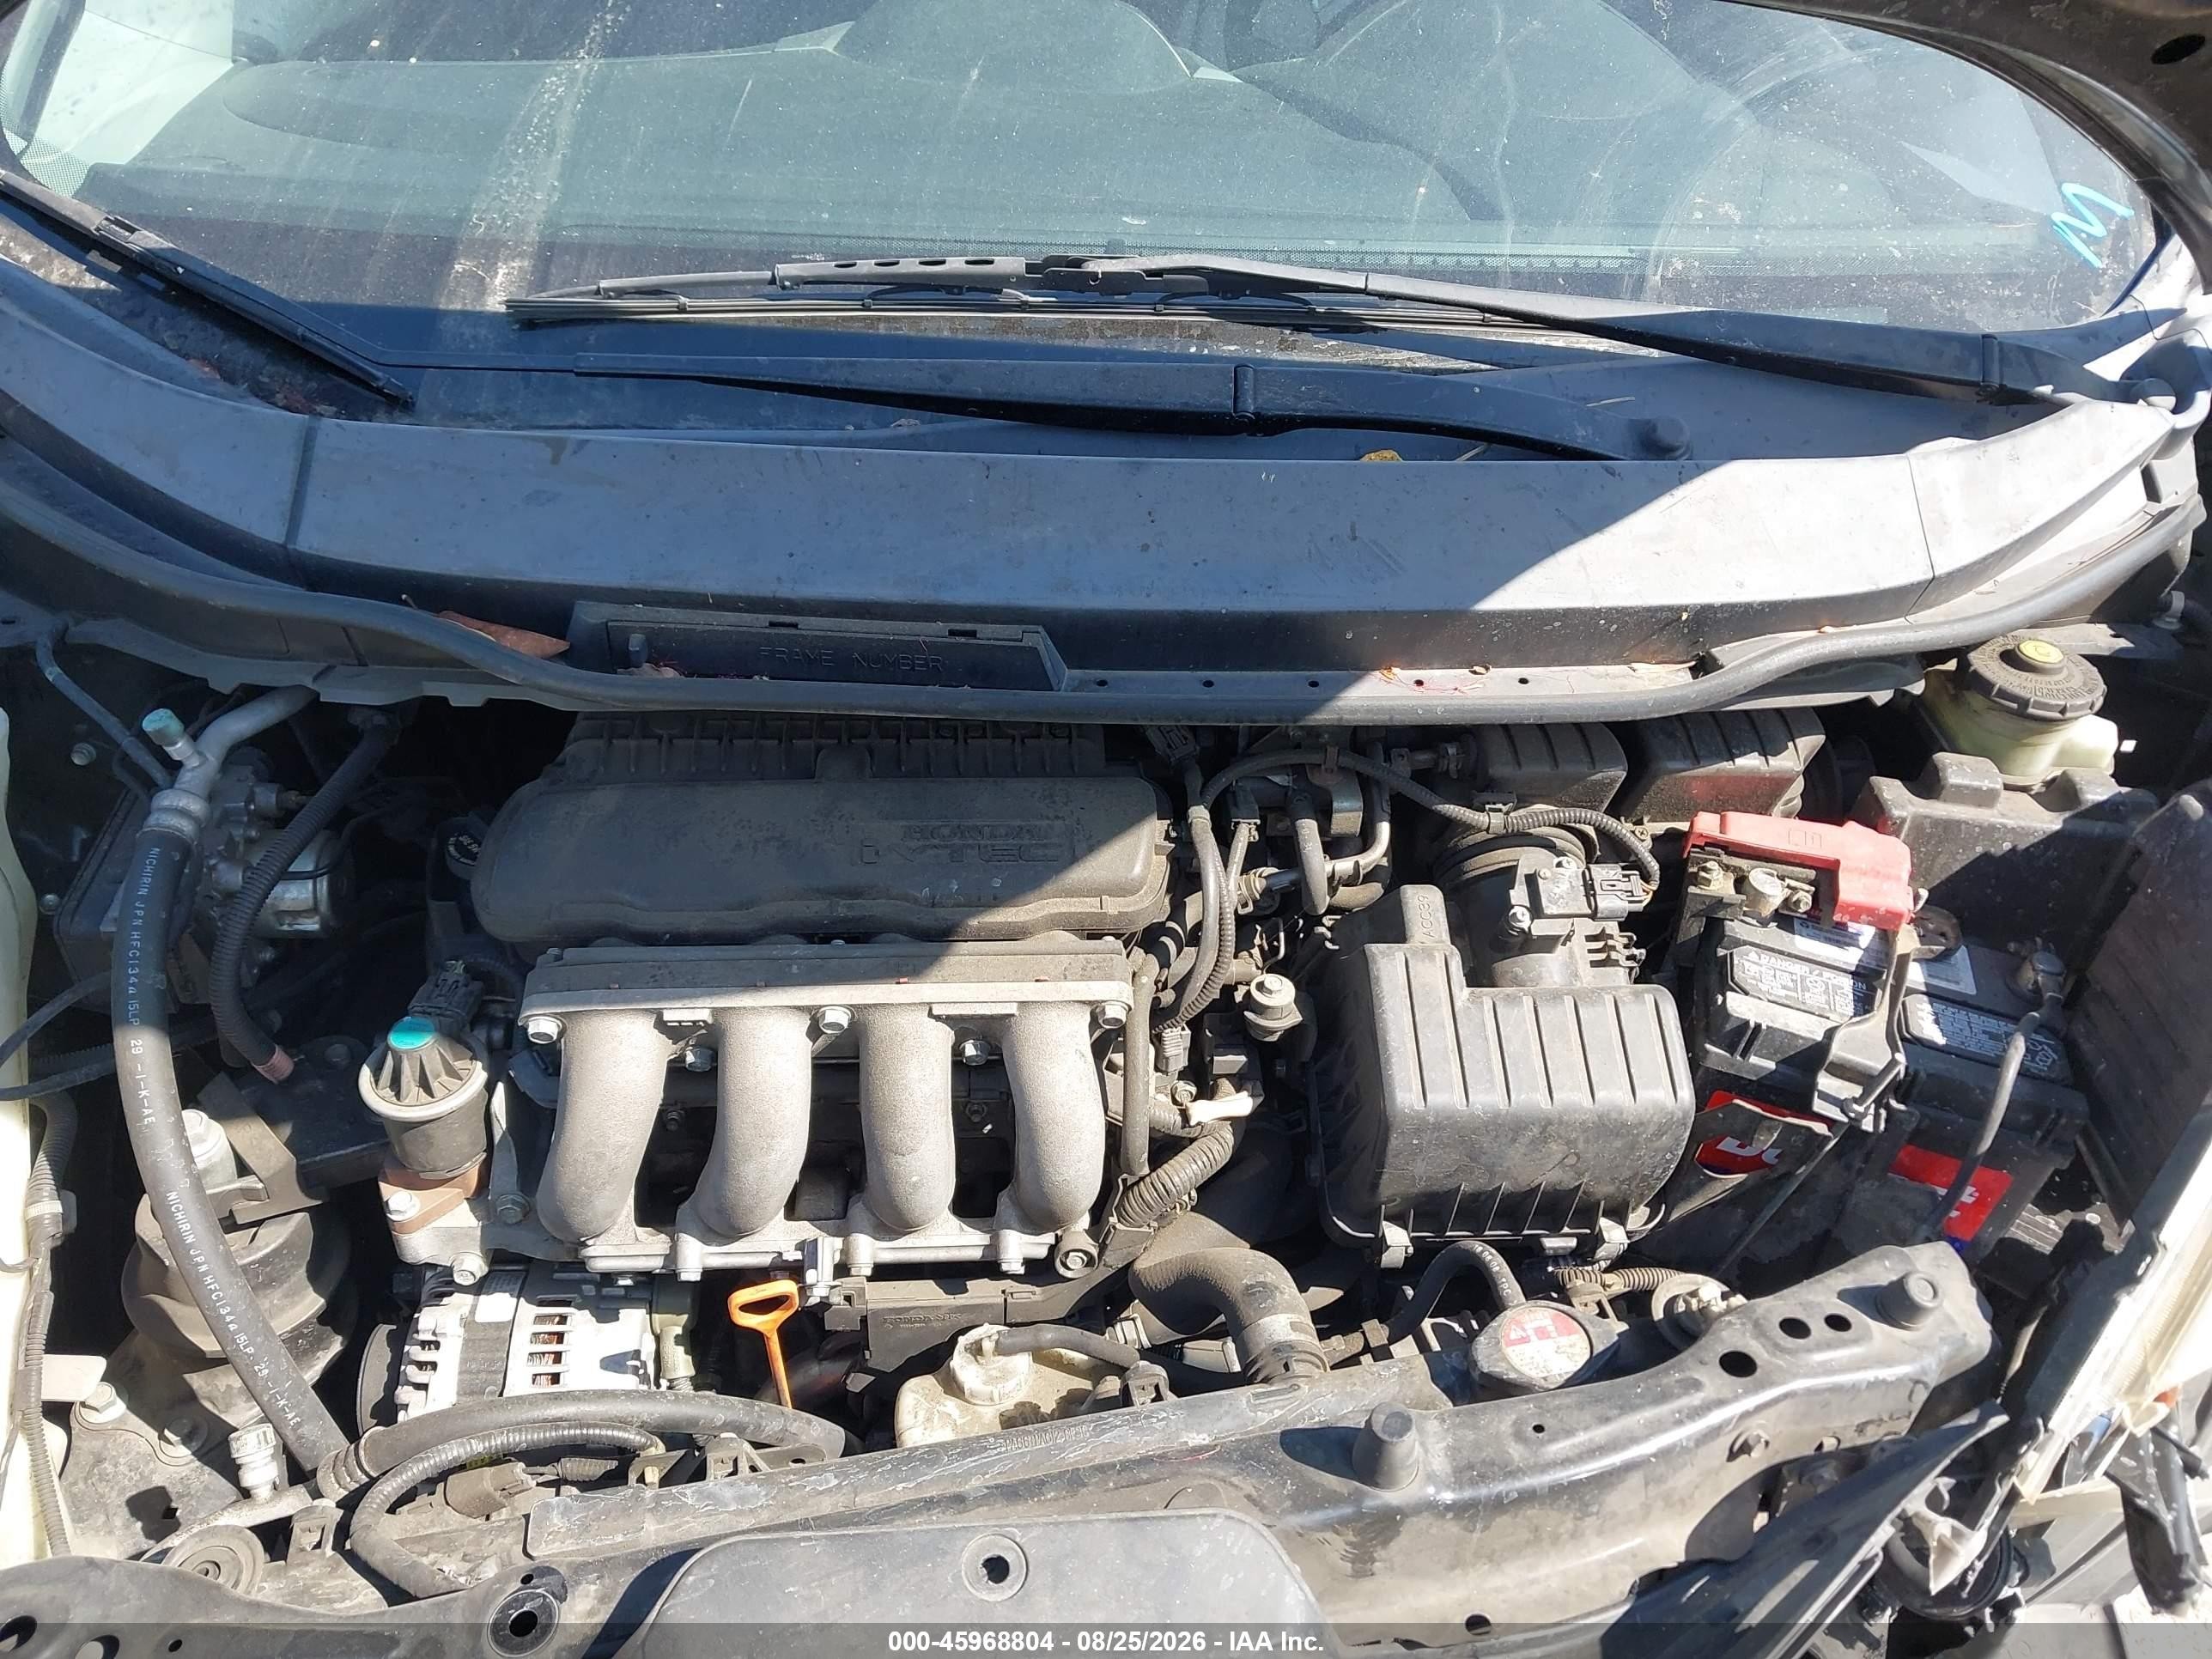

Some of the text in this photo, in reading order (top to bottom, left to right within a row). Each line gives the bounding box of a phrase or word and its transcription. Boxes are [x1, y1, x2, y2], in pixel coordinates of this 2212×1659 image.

[759, 647, 943, 672] FRAME NUMBER
[902, 823, 1044, 842] HONDA
[137, 847, 161, 895] NICHIRIN
[134, 901, 145, 926] JPN
[166, 1190, 197, 1245] NICHIRIN
[190, 1248, 210, 1273] JPN
